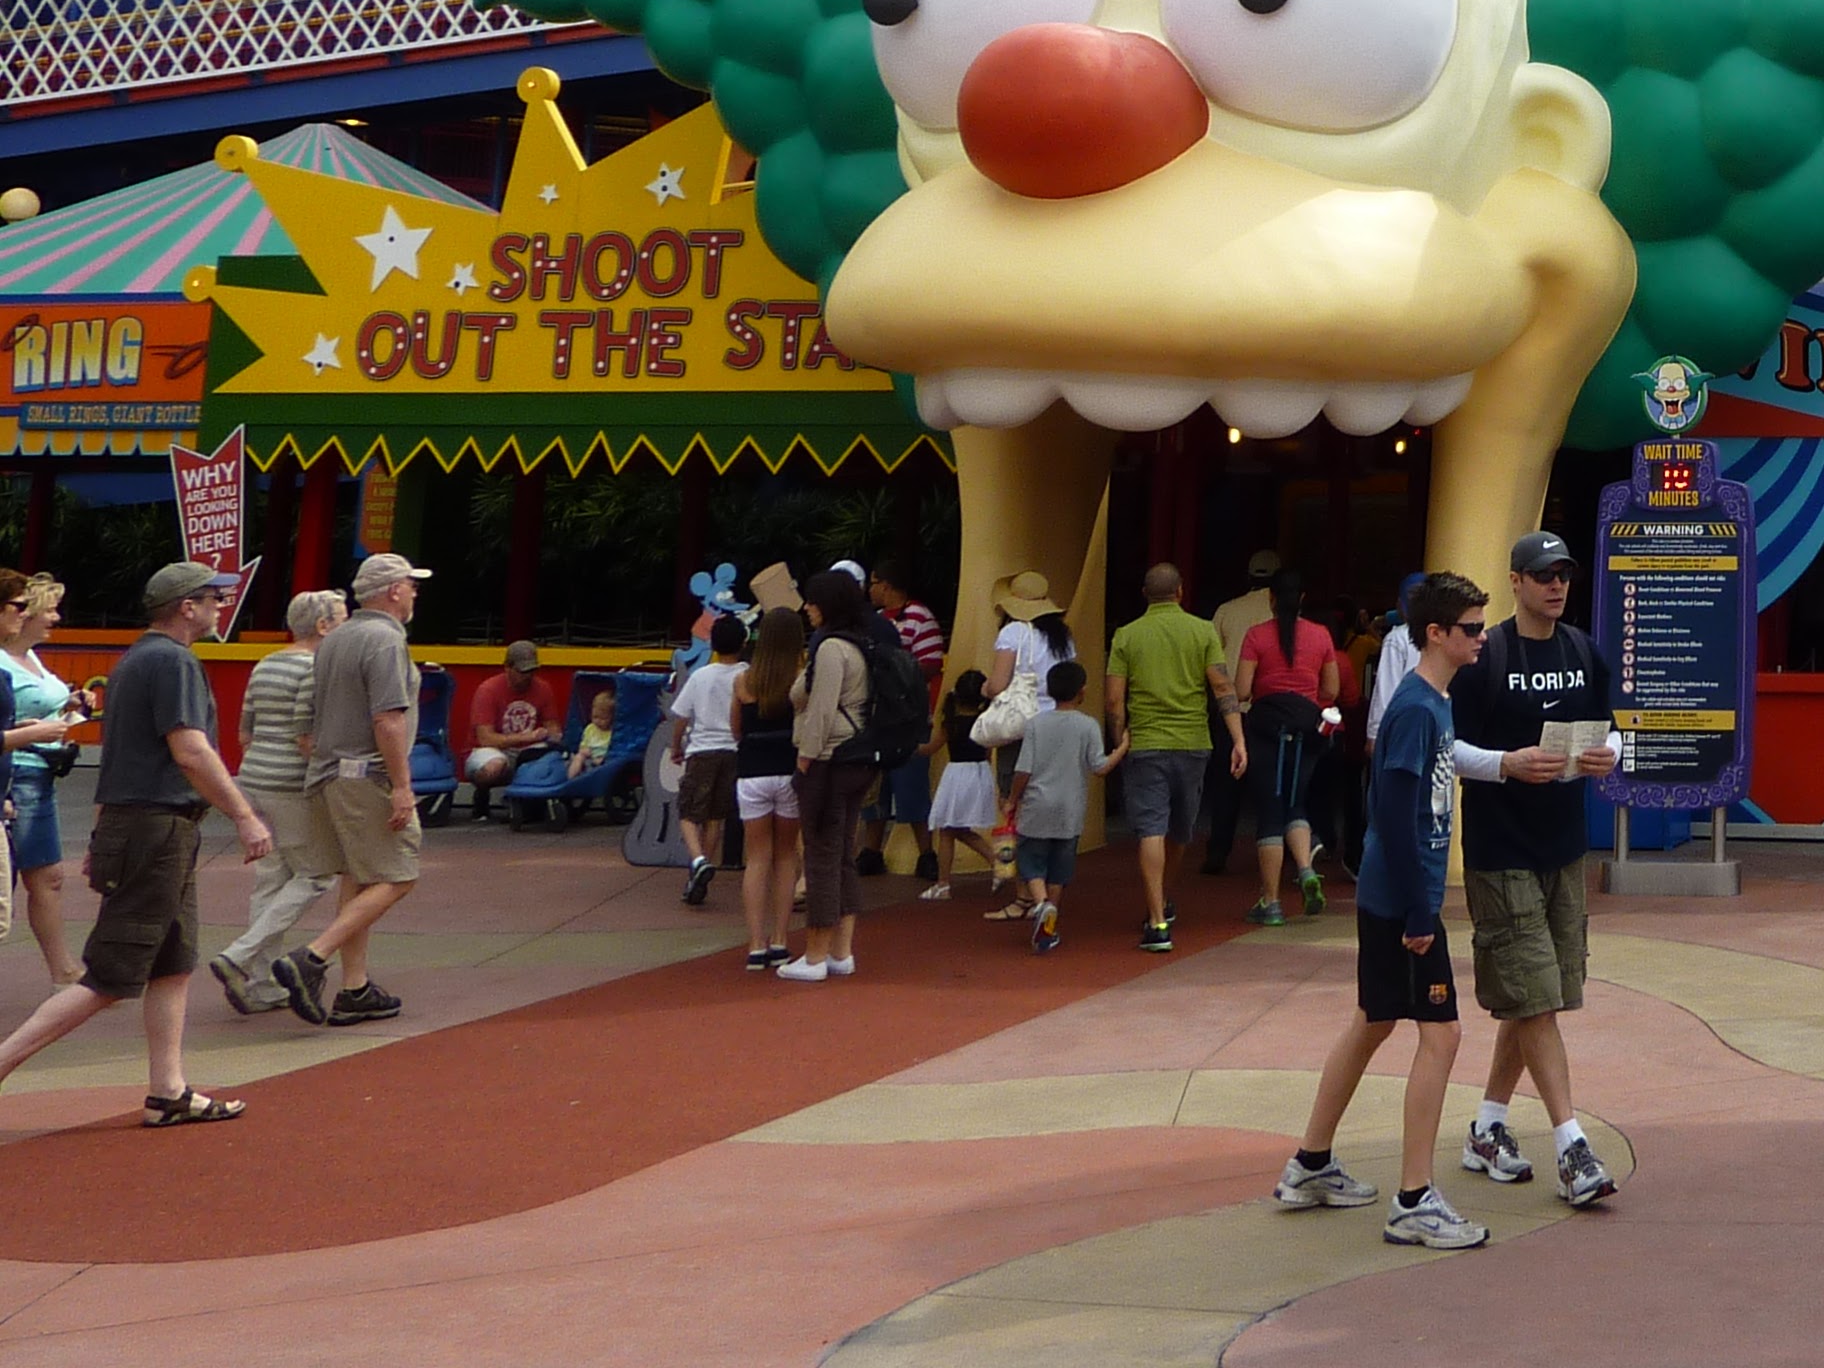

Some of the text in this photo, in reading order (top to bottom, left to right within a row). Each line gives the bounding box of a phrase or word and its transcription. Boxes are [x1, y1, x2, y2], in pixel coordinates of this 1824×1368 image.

[486, 227, 744, 302] SHOOT
[356, 298, 856, 381] OUT THE STA
[13, 316, 144, 394] RING
[27, 405, 65, 423] SMALL
[112, 405, 153, 423] GIANT
[1644, 444, 1703, 460] WAIT TIME
[181, 460, 237, 490] WHY
[185, 484, 237, 504] ARE YOU
[1648, 491, 1699, 507] MINUTES
[187, 498, 239, 517] LOOKING
[188, 511, 239, 534] DOWN
[1643, 525, 1704, 535] WARNING
[191, 531, 236, 554] HERE
[1508, 669, 1585, 692] FLORIDA
